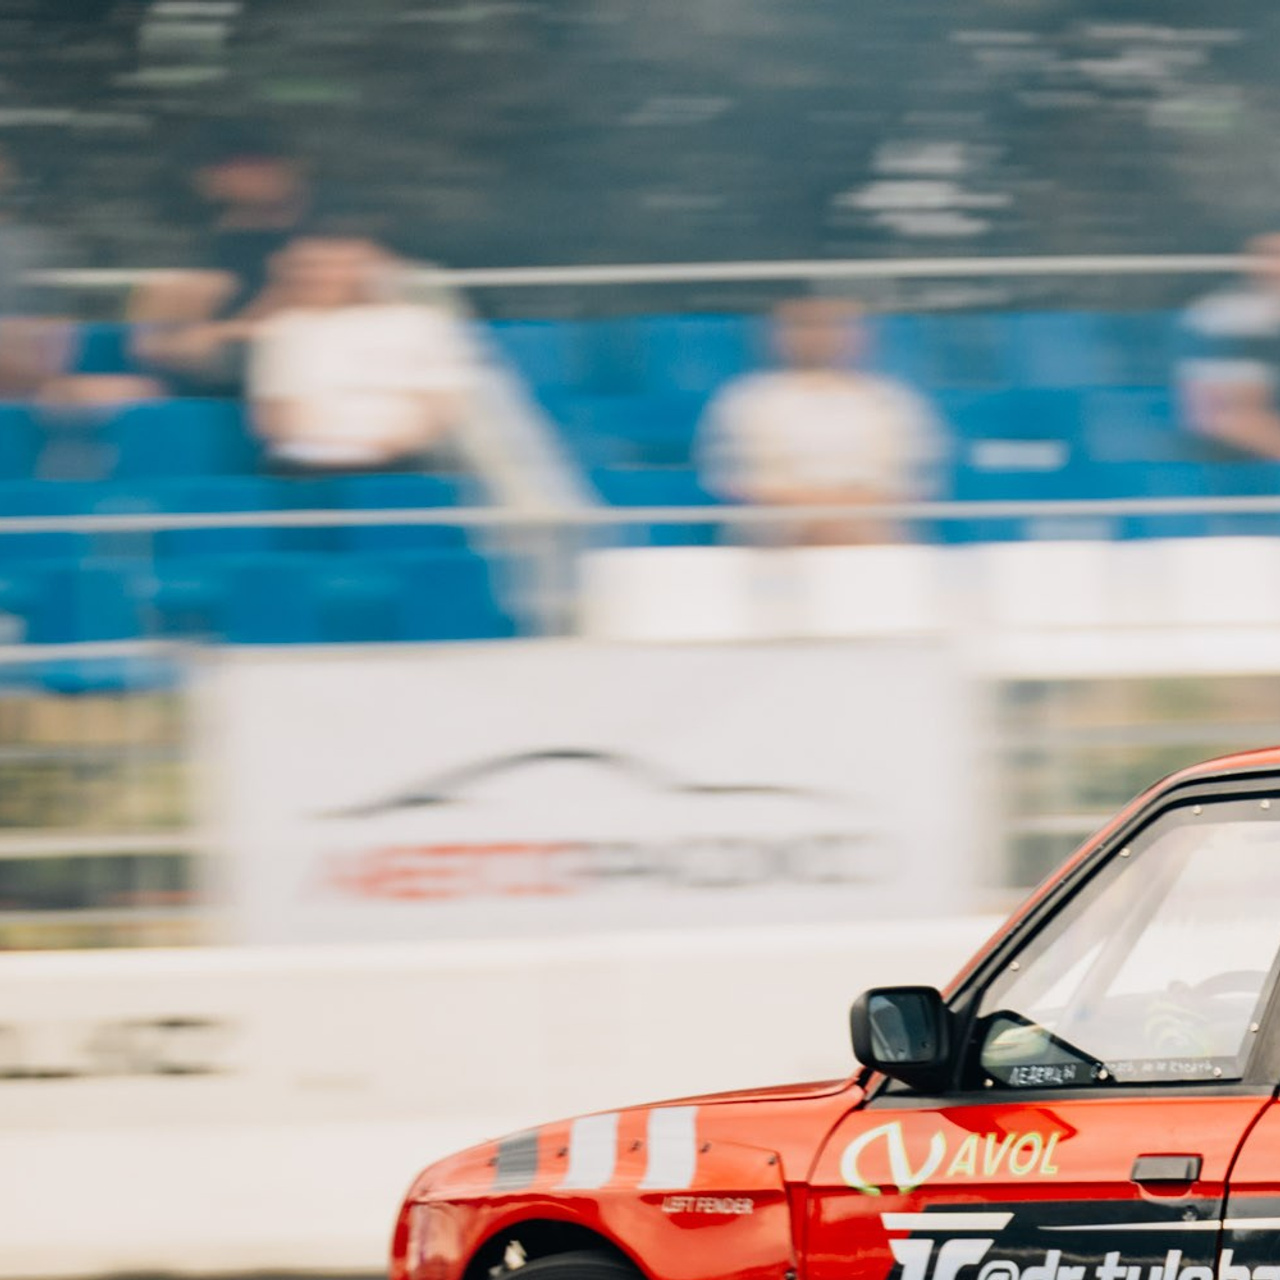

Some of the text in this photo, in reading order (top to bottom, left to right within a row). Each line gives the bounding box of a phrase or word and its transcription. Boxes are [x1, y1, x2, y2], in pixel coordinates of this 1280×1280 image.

[947, 1132, 1060, 1177] AVOL
[662, 1196, 754, 1214] LEFT FENDER
